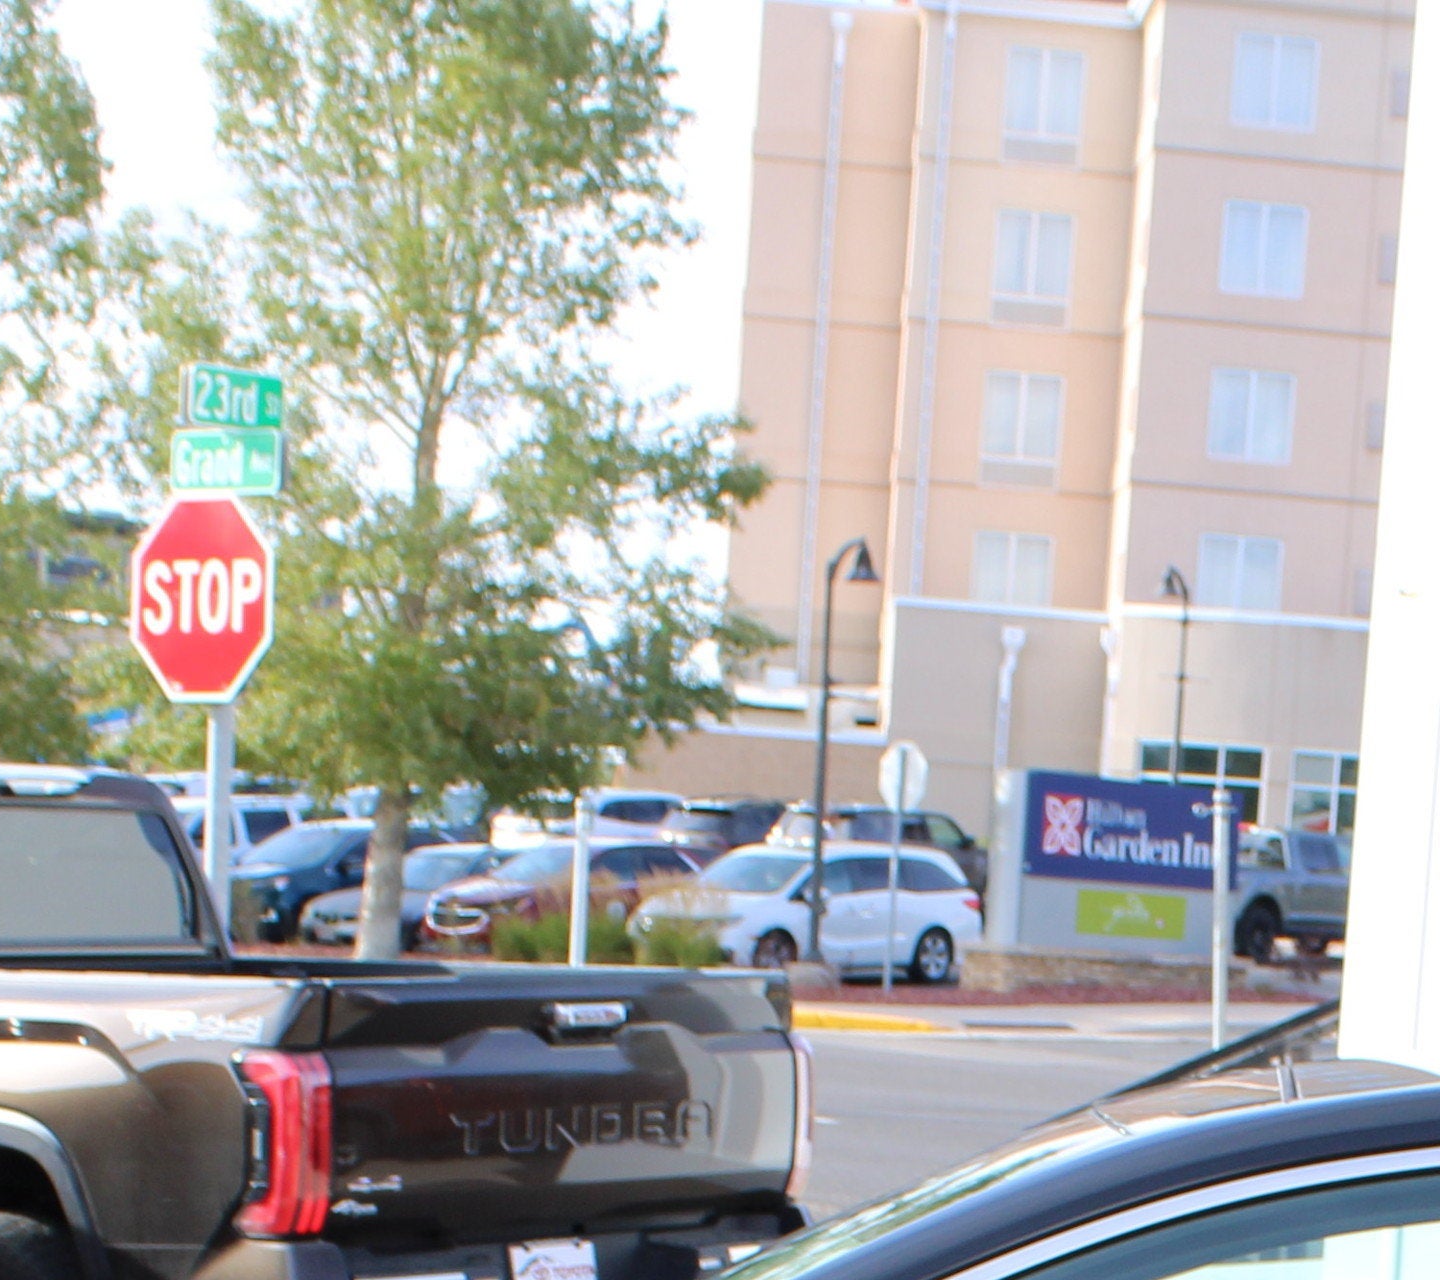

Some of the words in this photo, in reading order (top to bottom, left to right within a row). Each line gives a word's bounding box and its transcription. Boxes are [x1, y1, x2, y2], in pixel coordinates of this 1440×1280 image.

[194, 370, 259, 424] 23rd
[175, 438, 244, 487] Grand
[142, 557, 262, 635] STOP
[1083, 828, 1180, 868] Garden
[1182, 832, 1215, 869] In
[448, 1099, 713, 1156] TUNDRA
